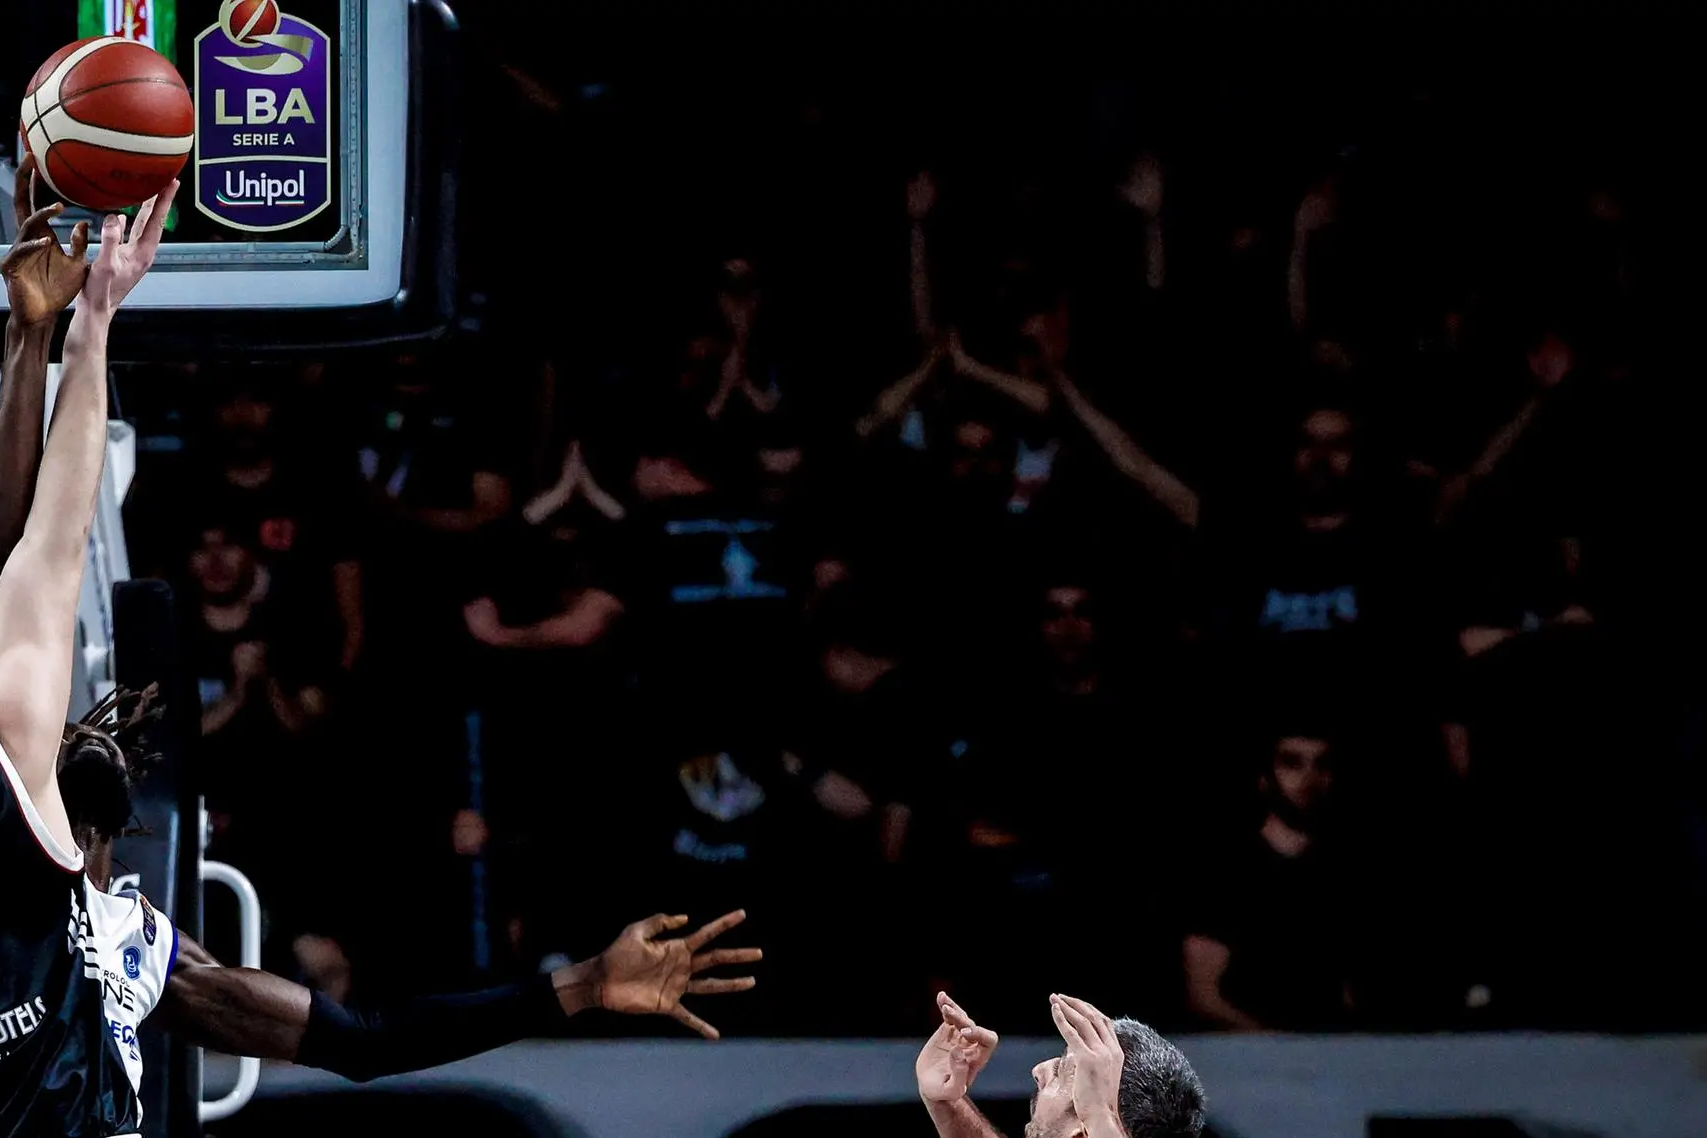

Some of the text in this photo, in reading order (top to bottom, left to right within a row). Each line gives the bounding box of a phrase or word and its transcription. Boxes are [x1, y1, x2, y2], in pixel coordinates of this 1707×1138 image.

[215, 88, 315, 125] LBA
[232, 133, 295, 146] SERIE A
[225, 169, 305, 206] Unipol
